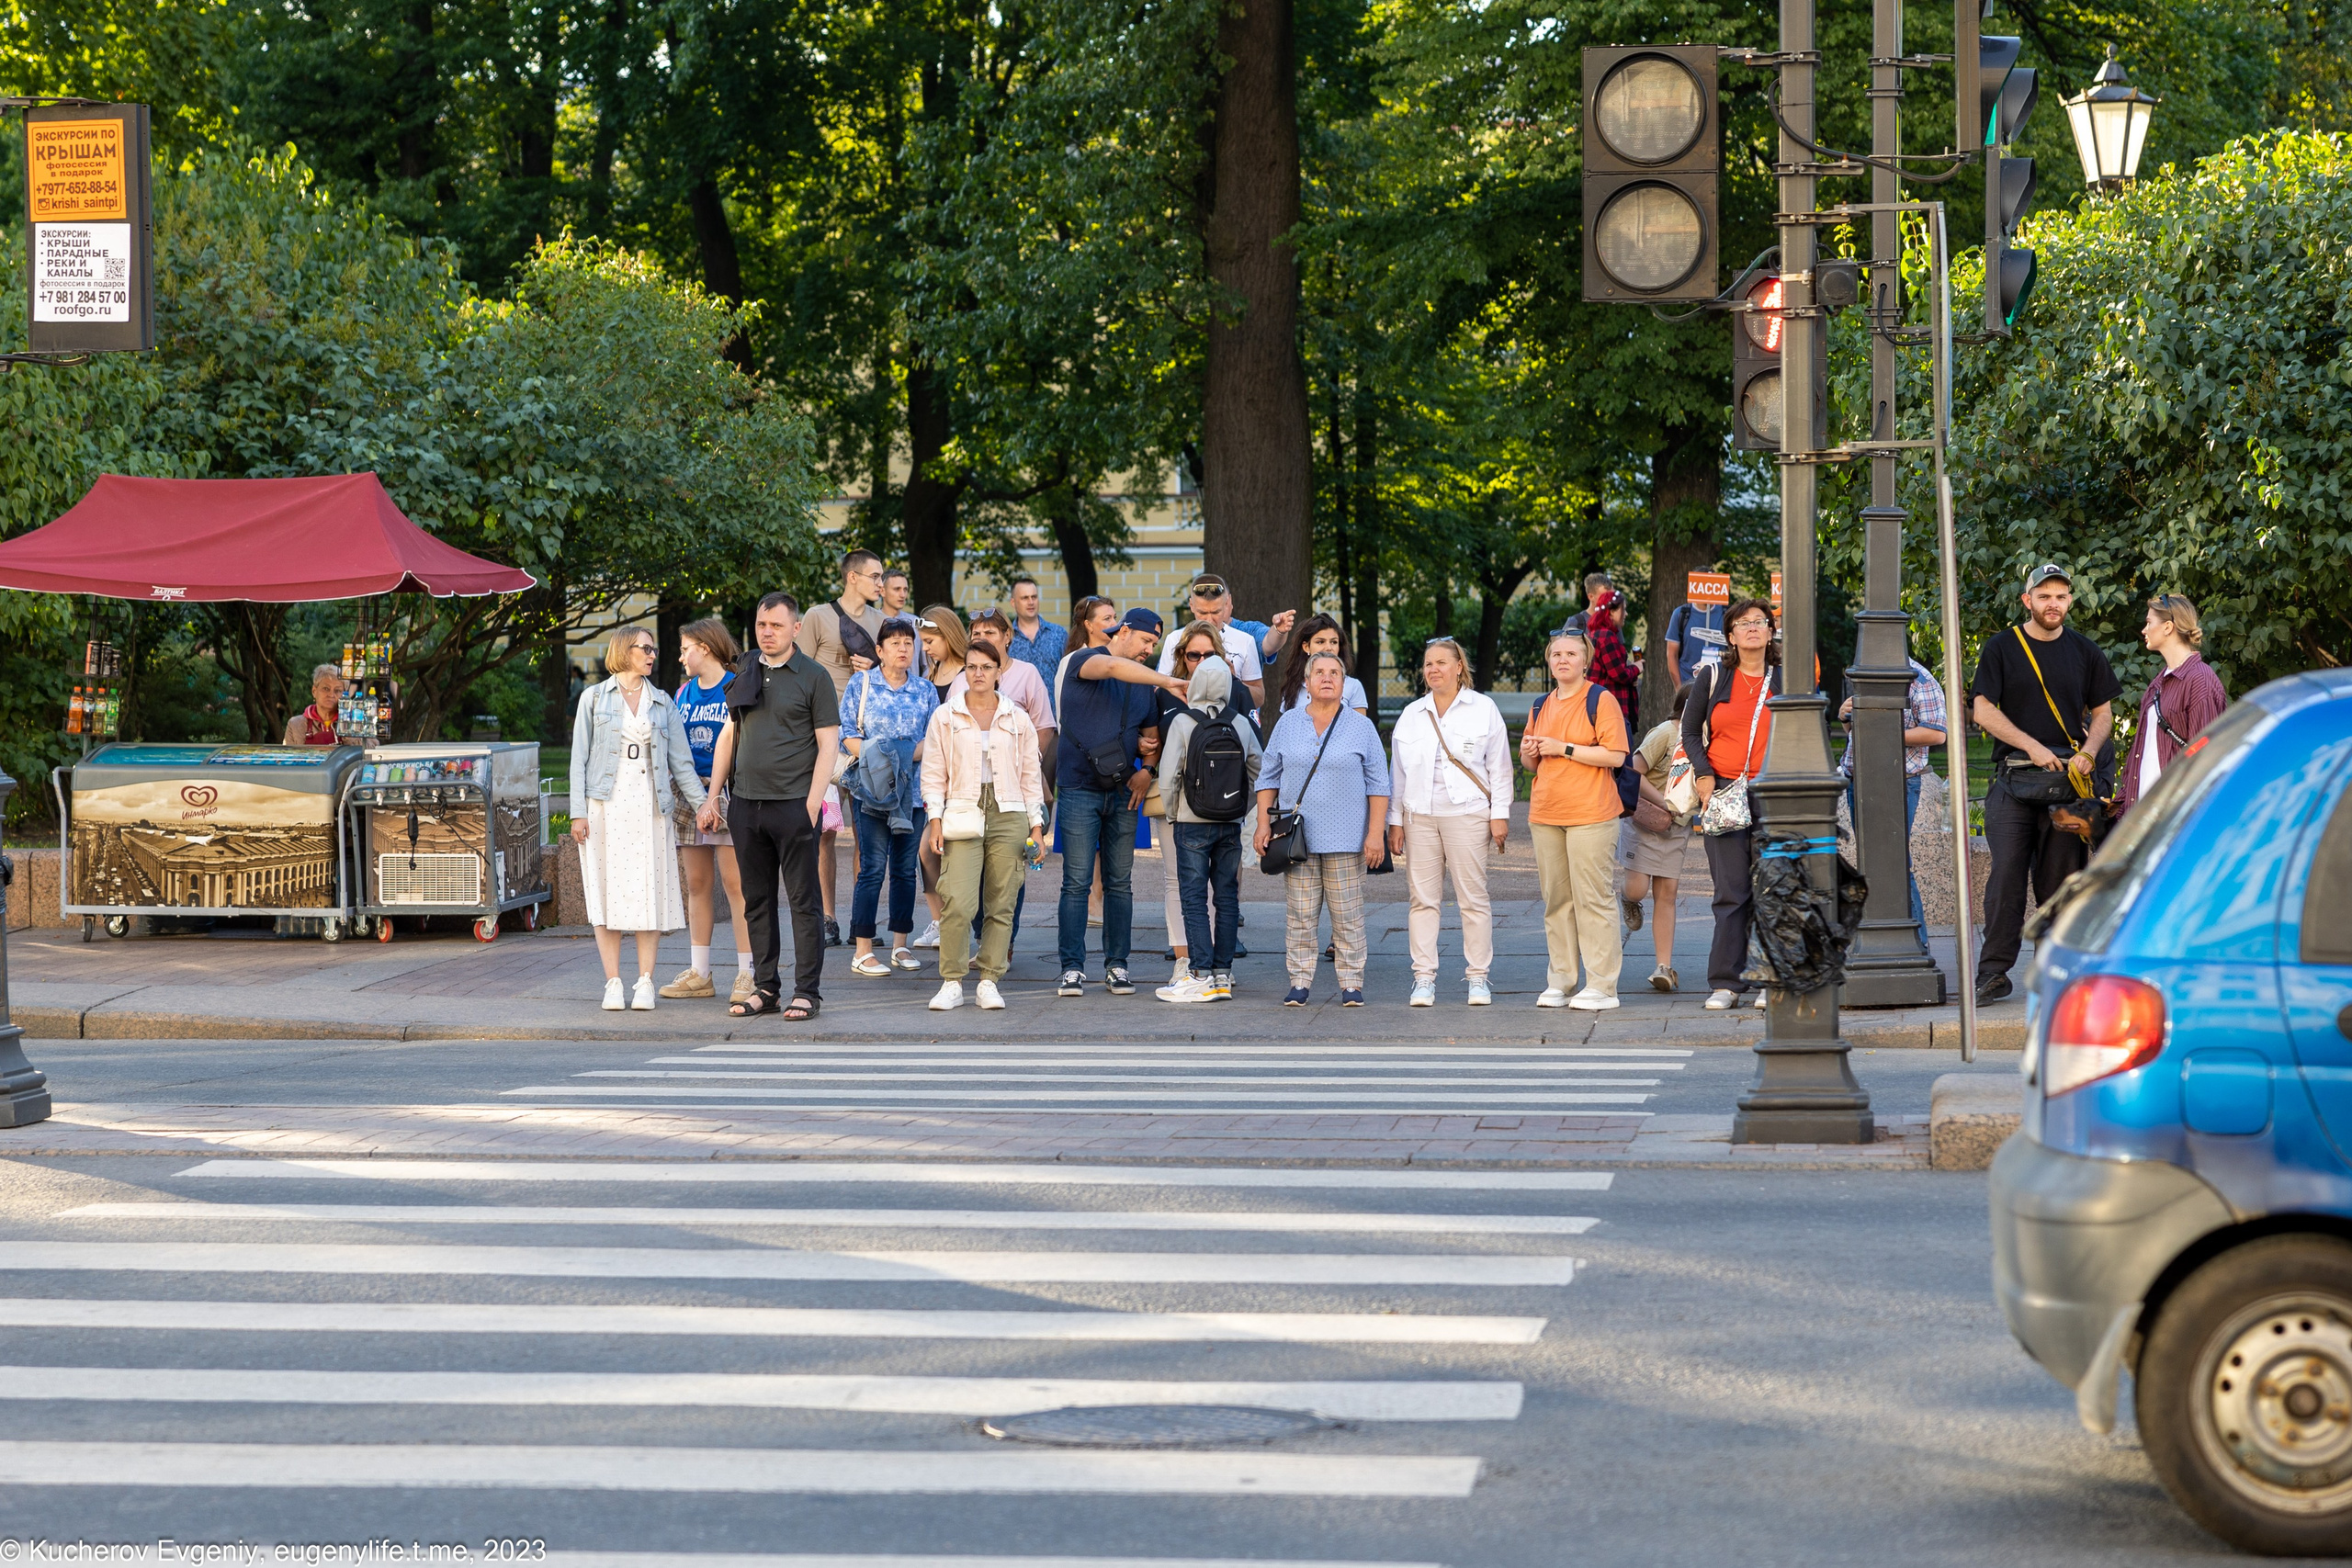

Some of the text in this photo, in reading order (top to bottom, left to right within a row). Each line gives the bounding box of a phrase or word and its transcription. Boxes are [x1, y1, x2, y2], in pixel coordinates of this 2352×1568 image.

[35, 130, 116, 141] ЭКСКУРСИИ ПО
[36, 142, 116, 161] КРЫШАМ
[46, 161, 107, 171] фотосессия
[60, 169, 103, 178] подарок
[36, 180, 117, 196] +7977-652-88-54
[40, 230, 92, 238] ЭКСКУРСИИ:
[47, 239, 90, 247] КРЫШИ
[47, 249, 109, 258] ПАРАДНЫЕ
[47, 259, 86, 267] РЕКИ И
[47, 269, 93, 277] КАНАЛЫ
[40, 279, 85, 288] фотосессия
[39, 290, 126, 303] +7 981 284 57 00
[54, 304, 111, 317] roofgo.ru
[1689, 581, 1728, 595] КАССА
[689, 702, 729, 724] ANGELE
[181, 806, 218, 820] Инмарко
